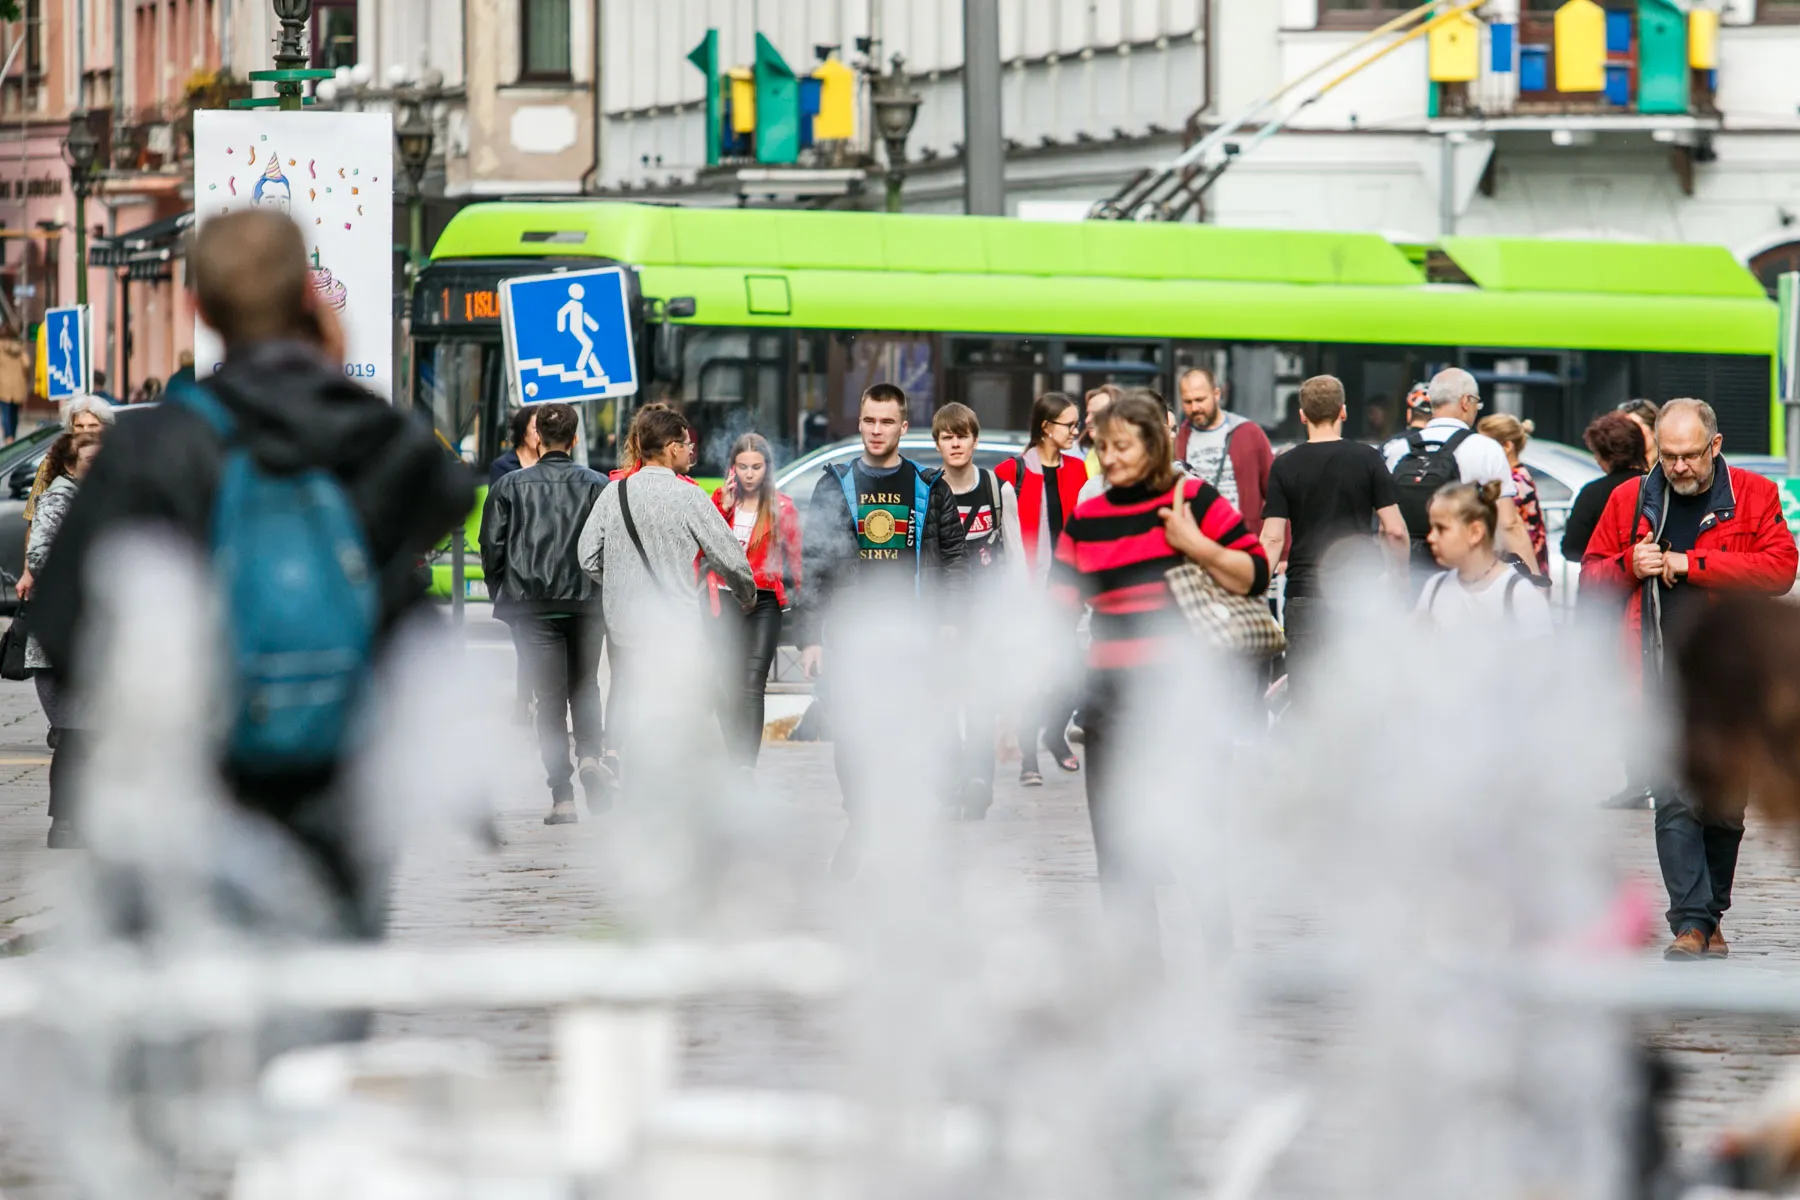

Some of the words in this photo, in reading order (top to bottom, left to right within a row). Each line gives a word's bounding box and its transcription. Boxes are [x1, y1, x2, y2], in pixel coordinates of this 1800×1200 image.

[442, 288, 449, 321] 1
[345, 363, 376, 378] 019
[860, 493, 901, 504] PARIS
[860, 549, 898, 560] PARIS
